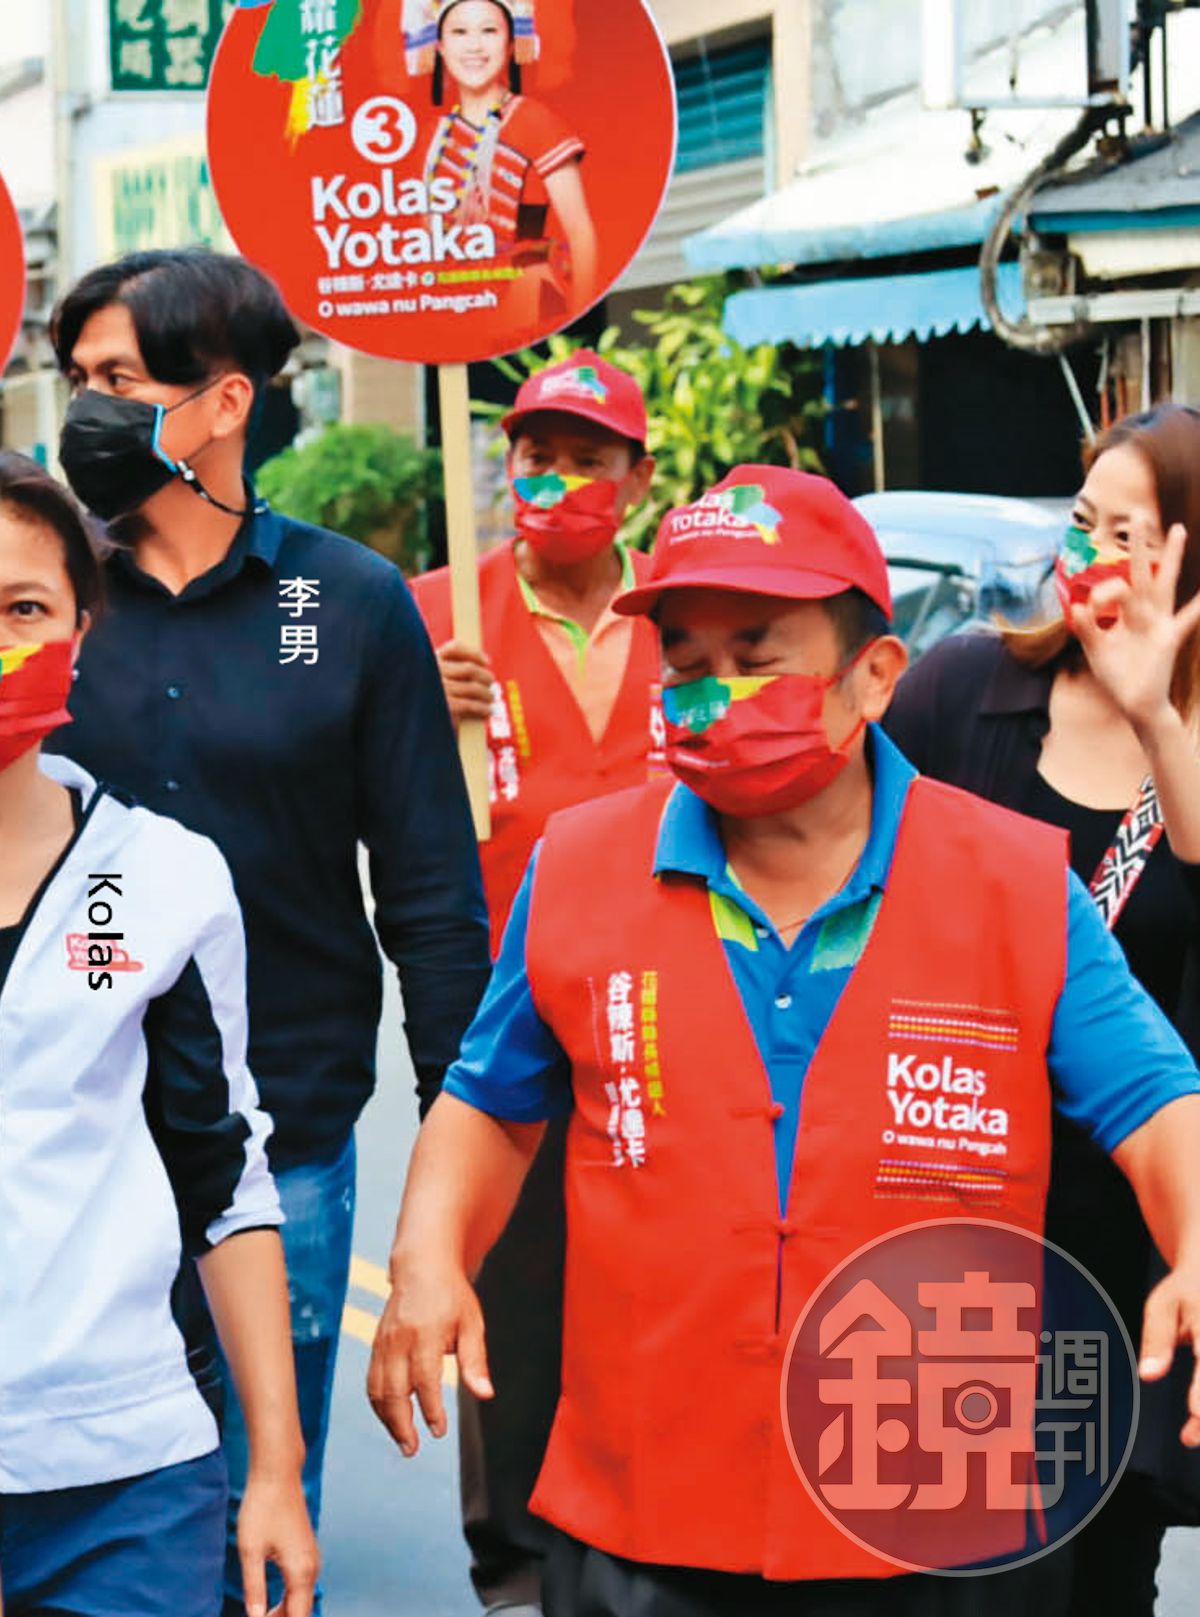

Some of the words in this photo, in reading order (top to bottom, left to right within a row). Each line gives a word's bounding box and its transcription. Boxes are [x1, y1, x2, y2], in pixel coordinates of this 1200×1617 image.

[362, 103, 406, 157] 3
[311, 168, 458, 221] Kolas
[313, 213, 496, 269] Yotaka
[318, 301, 333, 318] O
[336, 298, 390, 316] wawa
[392, 297, 417, 312] nu
[420, 289, 498, 313] Pangcah
[887, 1053, 986, 1096] Kolas
[887, 1089, 1008, 1136] Yotaka
[882, 1129, 896, 1144] O
